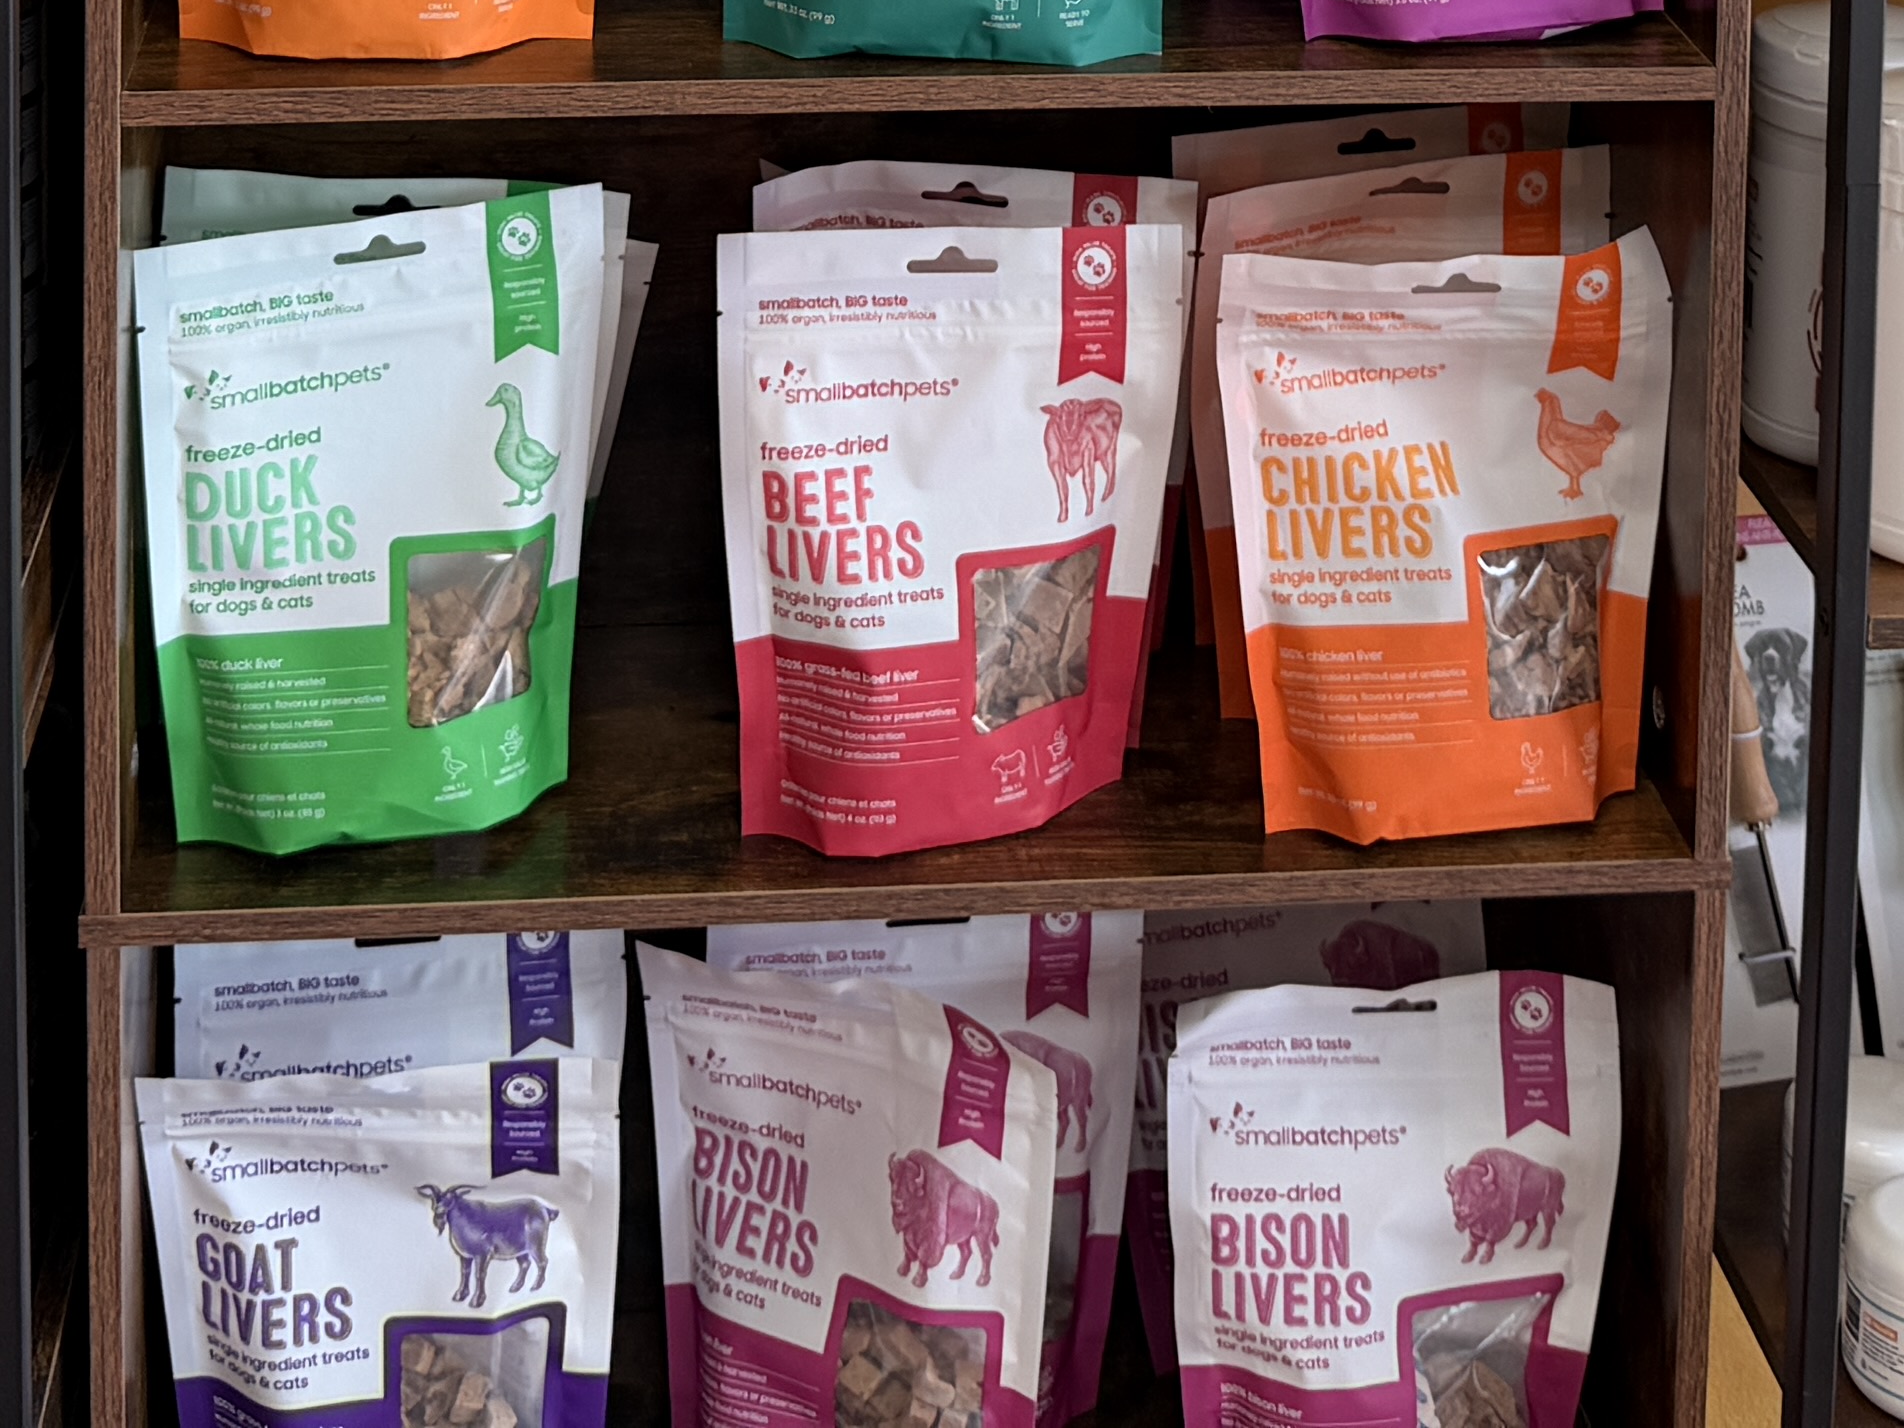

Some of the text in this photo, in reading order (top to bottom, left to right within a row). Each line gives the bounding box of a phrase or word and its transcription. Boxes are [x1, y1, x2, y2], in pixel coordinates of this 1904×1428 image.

[186, 455, 319, 523] DUCK
[762, 464, 874, 527] BEEF
[1261, 440, 1460, 506] CHICKEN
[187, 505, 356, 572] LIVERS
[766, 522, 924, 586] LIVERS
[1266, 503, 1433, 562] LIVERS
[197, 1233, 298, 1296] GOAT
[1210, 1213, 1350, 1269] BISON
[202, 1286, 353, 1350] LIVERS
[1211, 1272, 1371, 1328] LIVERS
